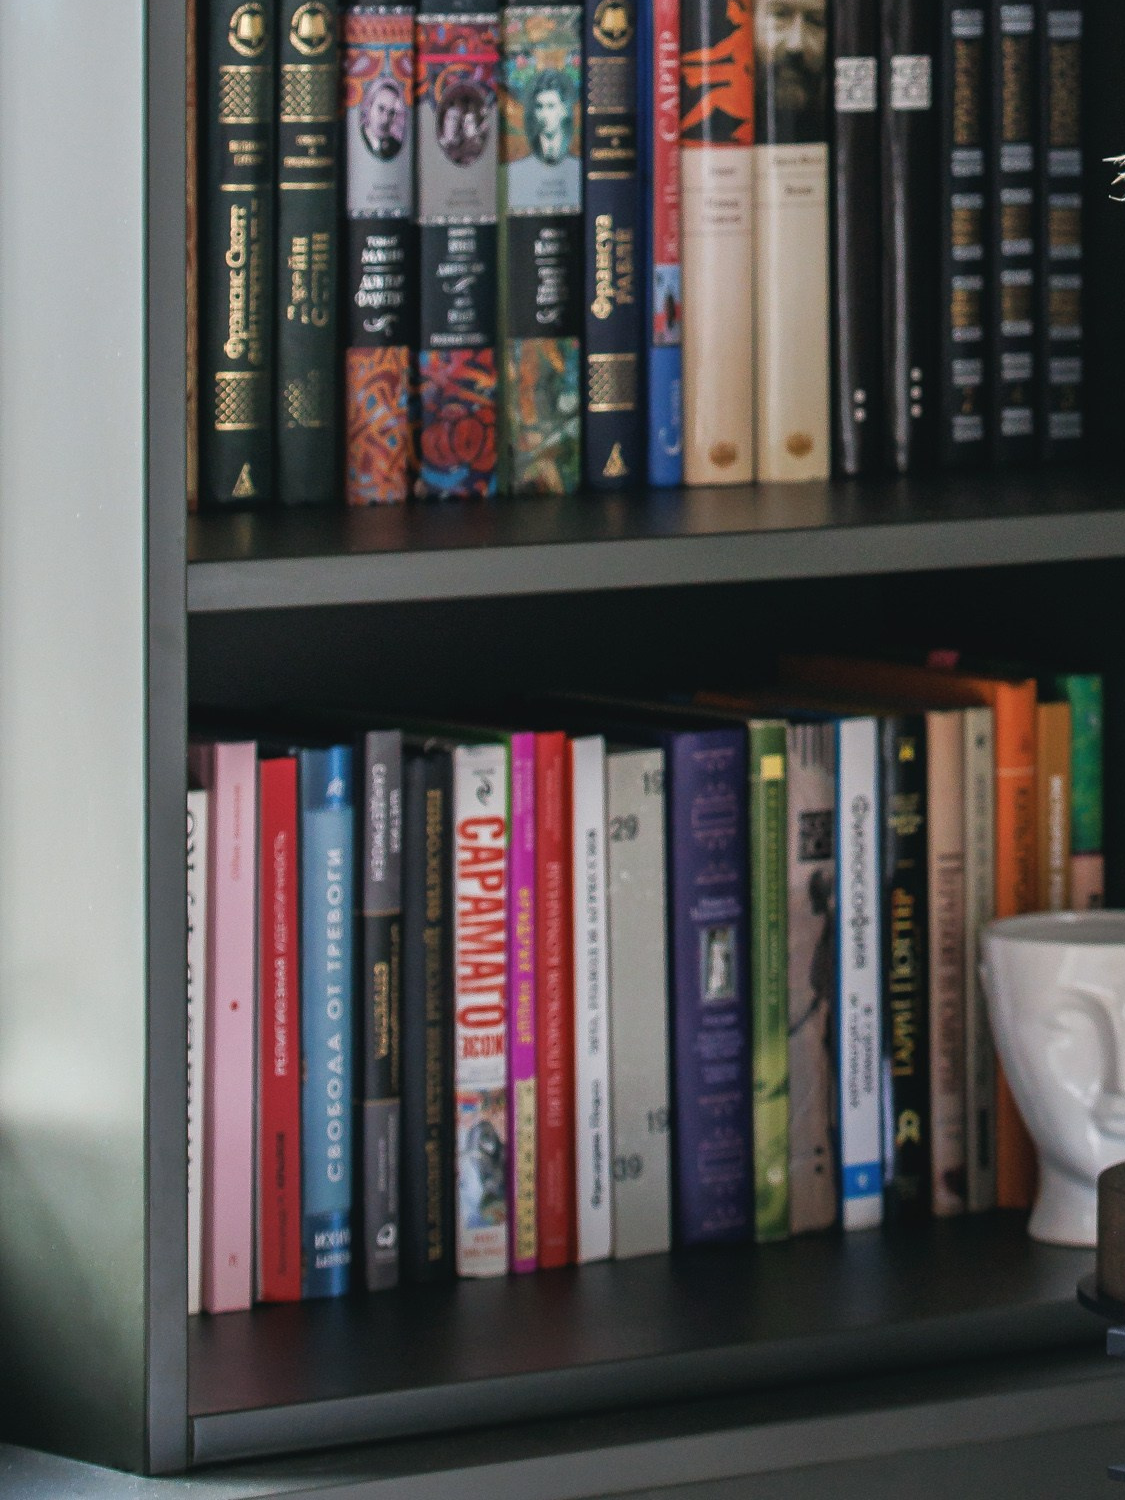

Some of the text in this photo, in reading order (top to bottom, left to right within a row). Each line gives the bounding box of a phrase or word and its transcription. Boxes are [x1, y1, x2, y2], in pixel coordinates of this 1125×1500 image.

[223, 203, 250, 361] Фрэнсис Скотт
[590, 214, 617, 320] Франсуа
[325, 846, 345, 1185] СВОБОДА ОТ ТРЕВОГИ
[455, 814, 508, 1030] САРАМАГО
